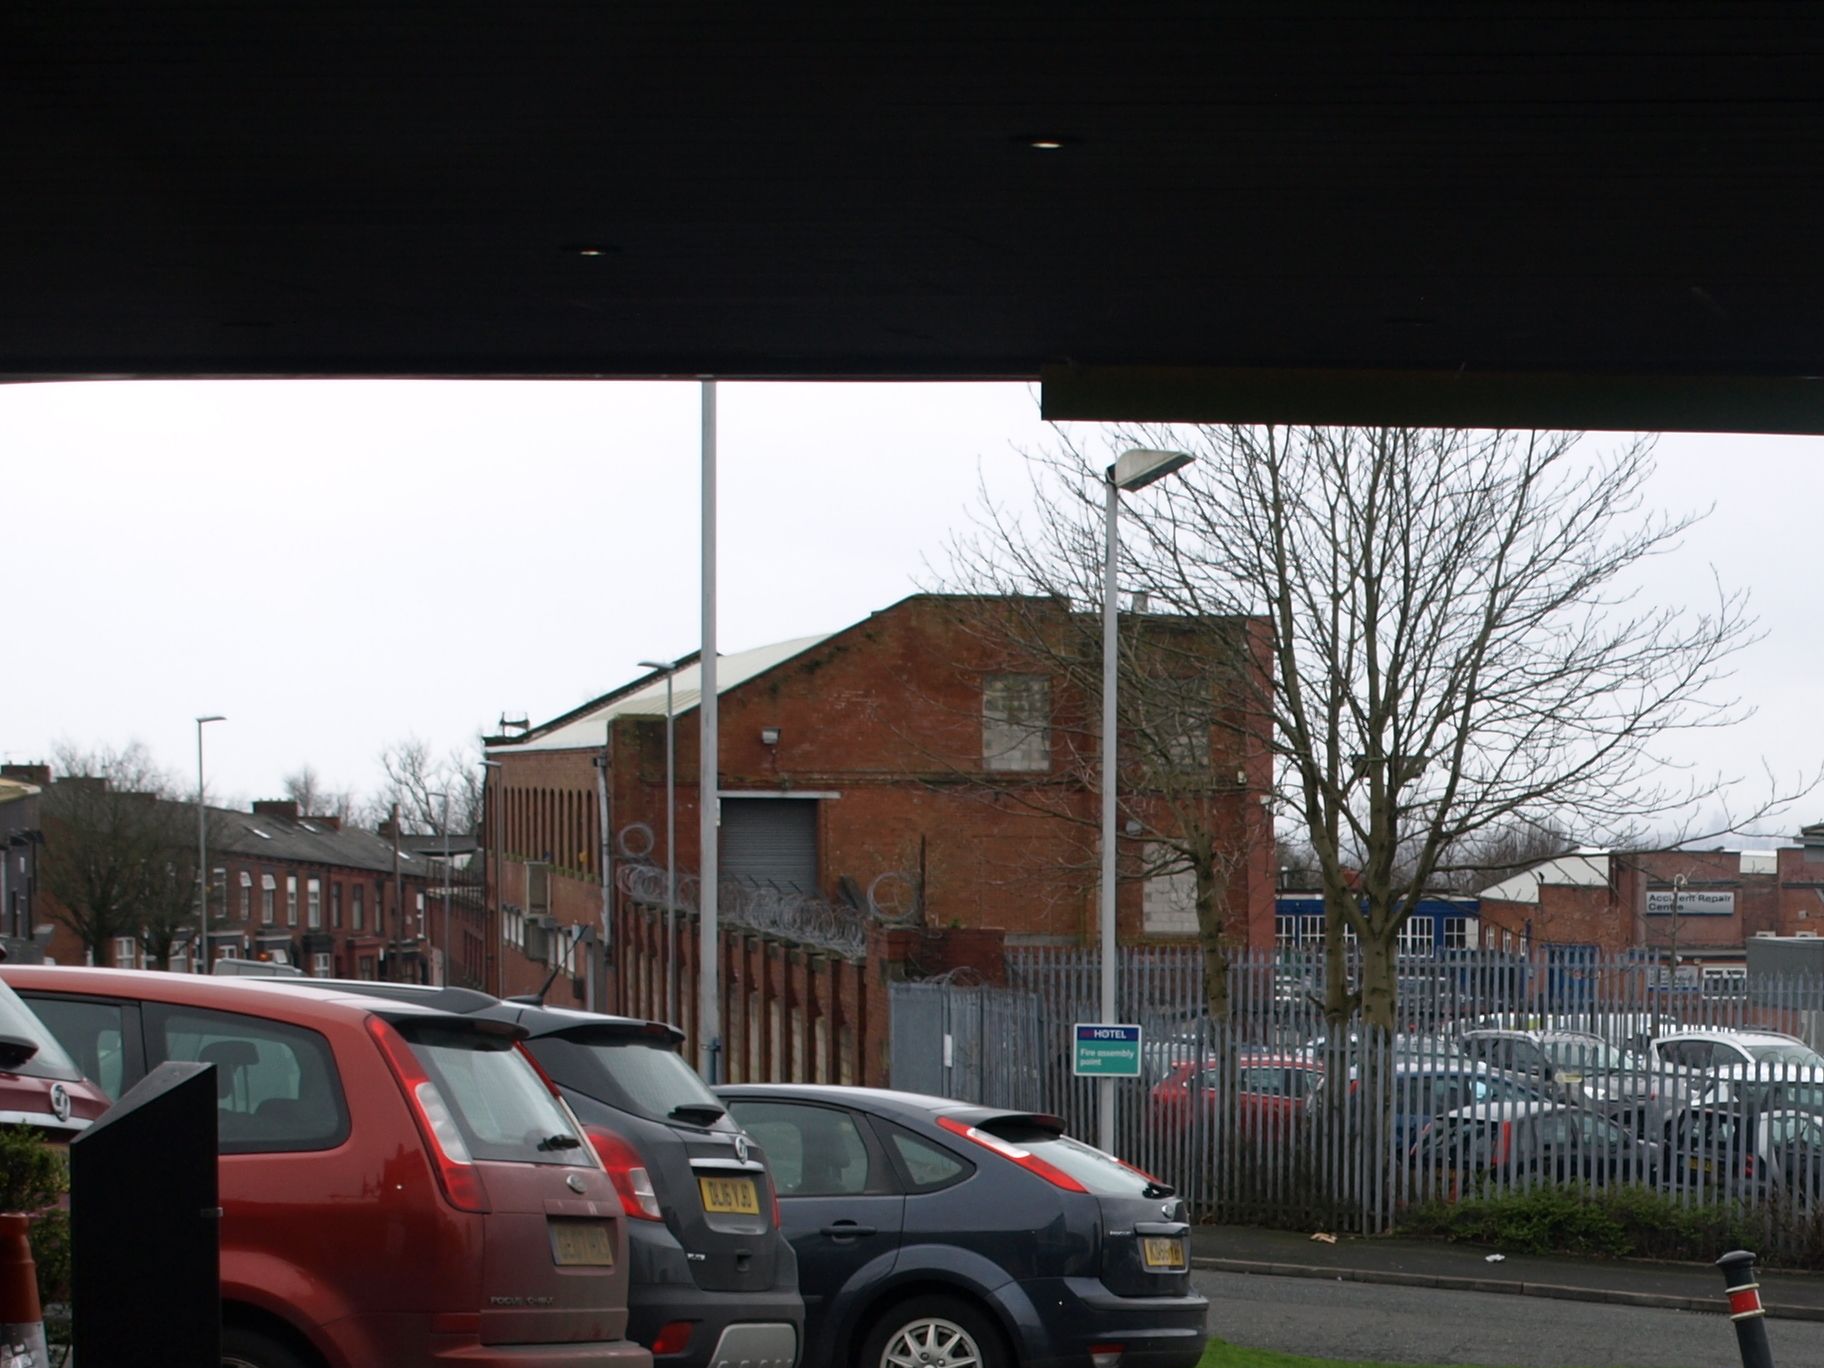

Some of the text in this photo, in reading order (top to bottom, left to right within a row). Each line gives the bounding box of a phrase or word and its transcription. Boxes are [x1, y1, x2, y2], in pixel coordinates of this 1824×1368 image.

[1649, 894, 1731, 903] Accient Repair
[1648, 903, 1684, 911] Cente
[1094, 1030, 1127, 1039] HOTEL
